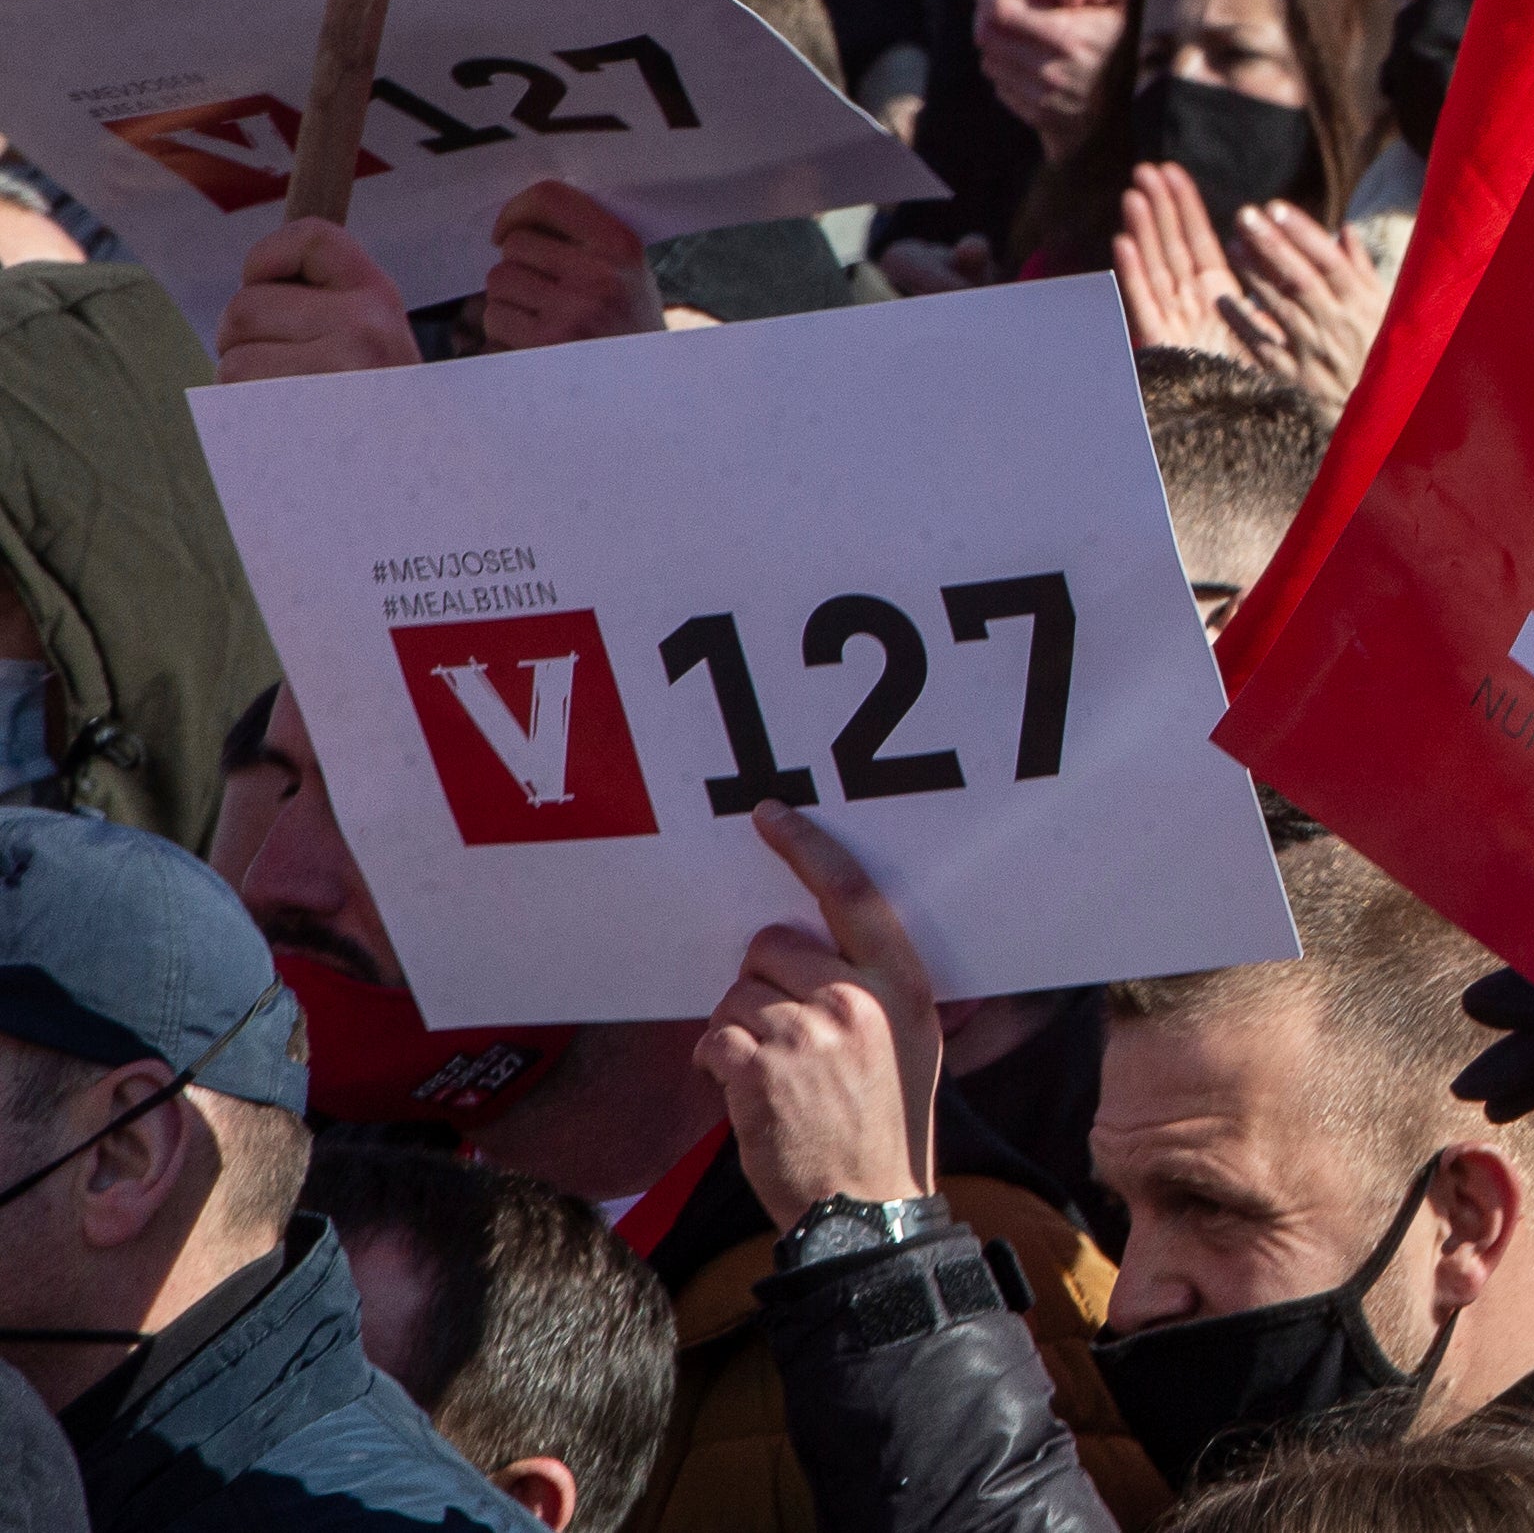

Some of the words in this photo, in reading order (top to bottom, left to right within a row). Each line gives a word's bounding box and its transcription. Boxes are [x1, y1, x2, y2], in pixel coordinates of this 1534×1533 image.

[367, 35, 702, 154] 127
[371, 545, 537, 585] #MEVJOSEN
[382, 580, 558, 620] #MEALBININ
[431, 650, 581, 809] V
[656, 570, 1078, 817] 127
